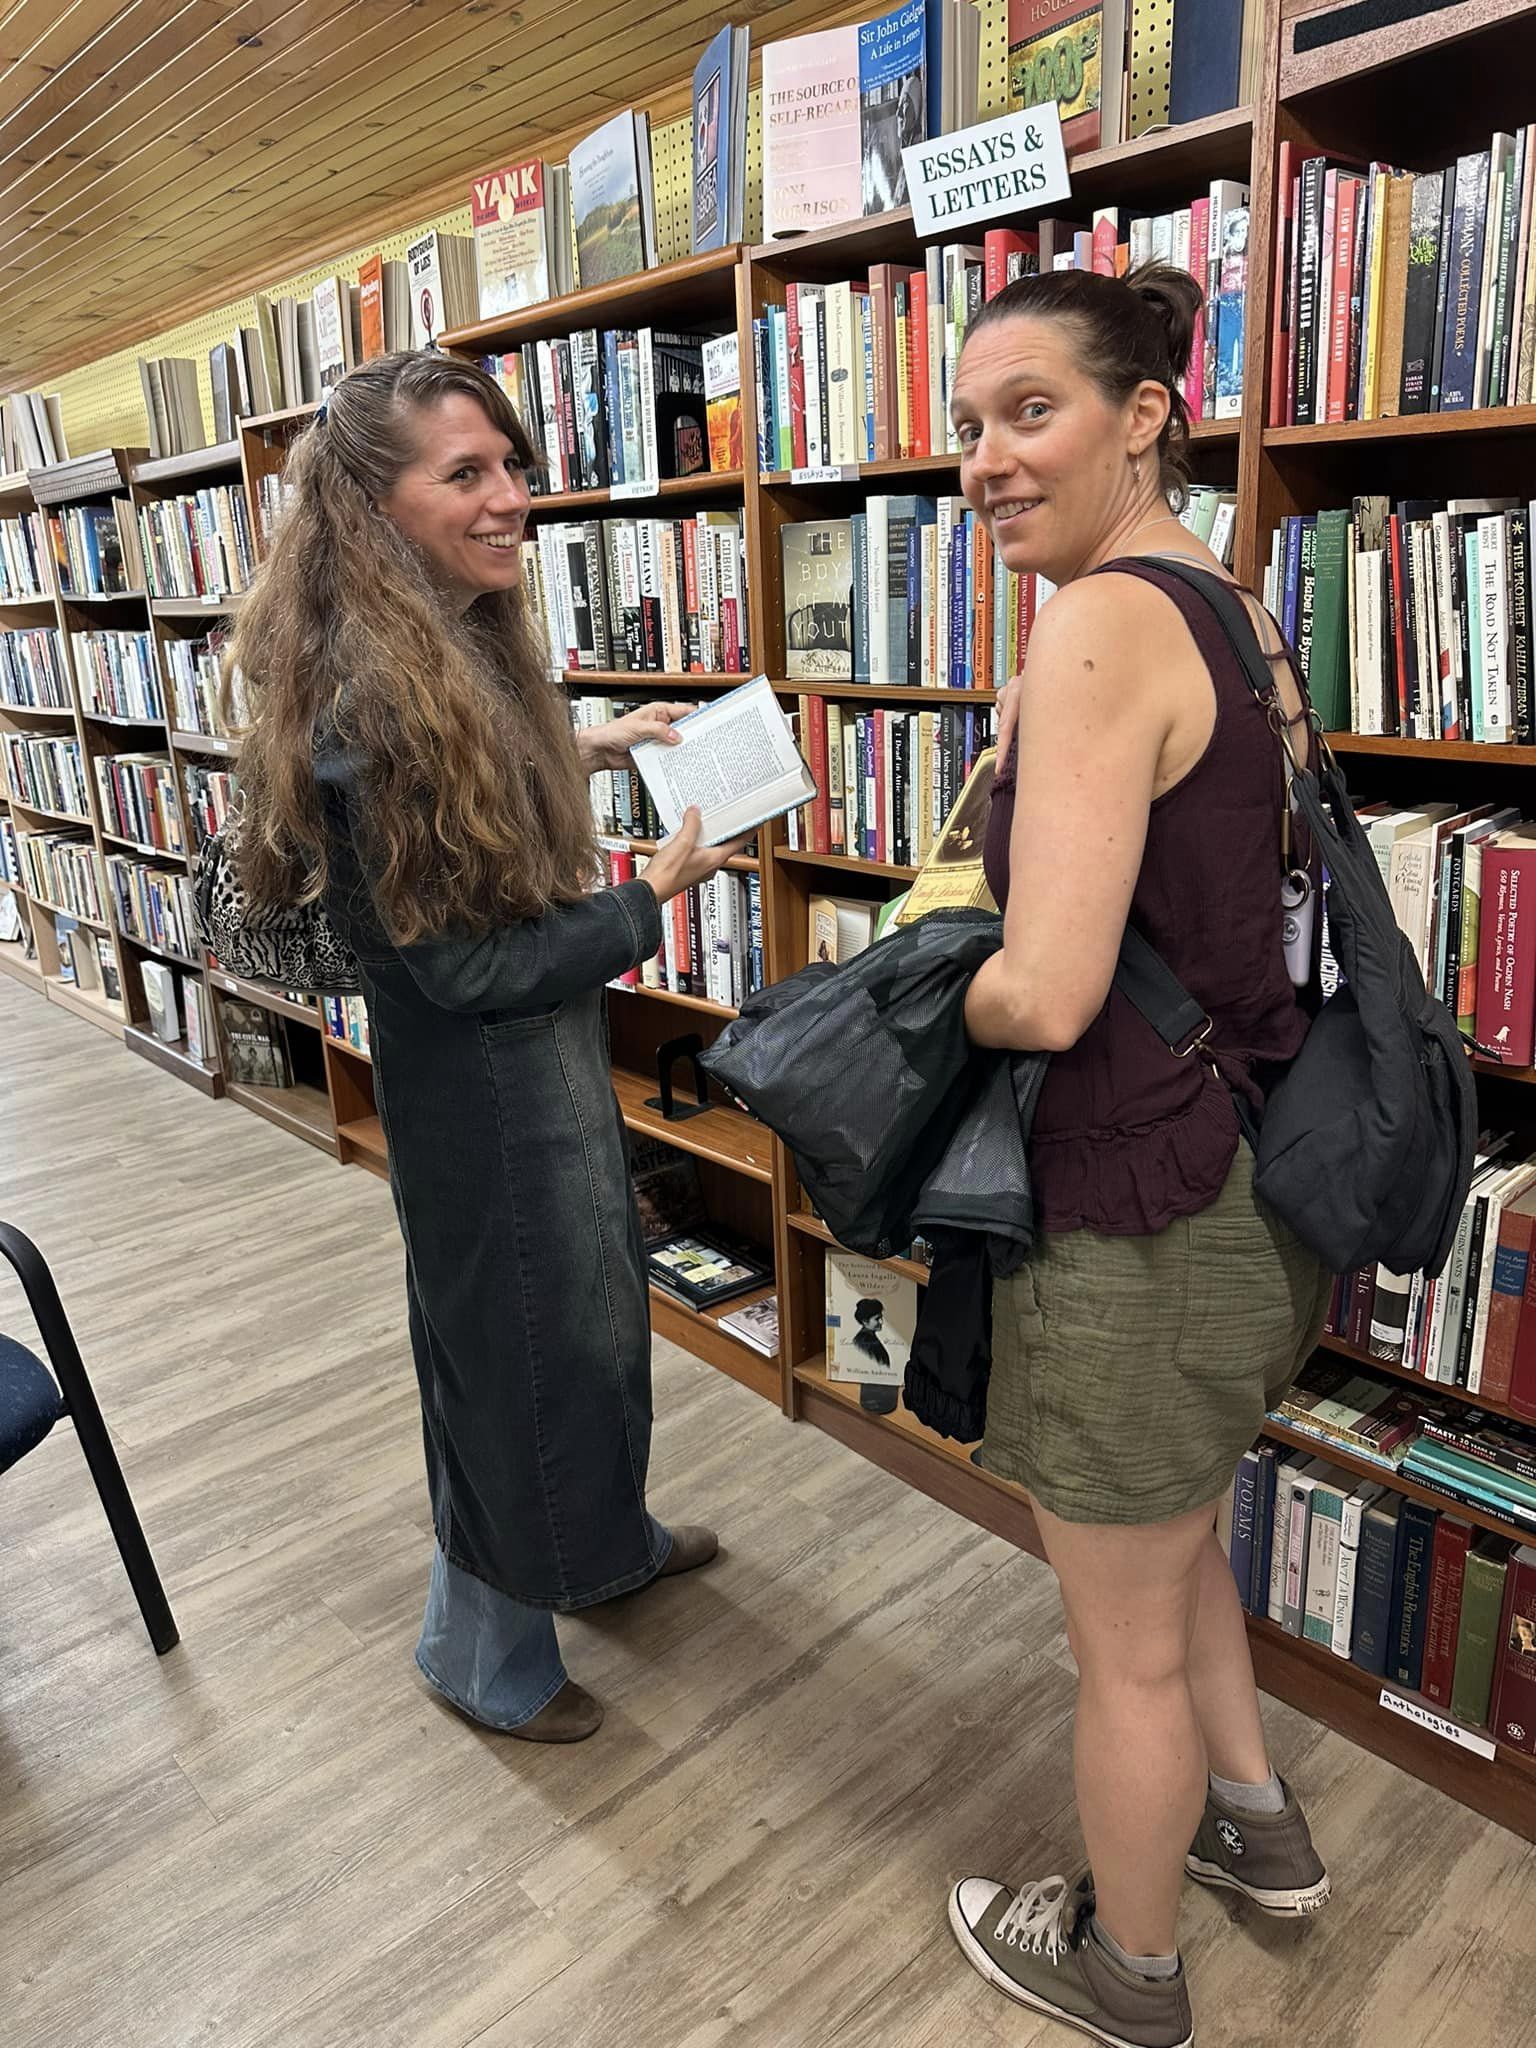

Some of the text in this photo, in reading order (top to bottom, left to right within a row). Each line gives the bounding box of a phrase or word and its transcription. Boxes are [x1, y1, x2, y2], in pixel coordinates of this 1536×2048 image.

[861, 30, 874, 45] Sir
[877, 19, 898, 42] John
[871, 27, 920, 60] A Life in Letters
[770, 77, 857, 106] THE SOURCE O
[919, 124, 1044, 184] ESSAYS &
[474, 165, 538, 210] YANK
[928, 162, 1048, 219] LETTERS
[1504, 183, 1512, 212] JAMES
[408, 234, 435, 263] BODYGUARD
[414, 254, 431, 275] OF LIES
[1499, 247, 1508, 293] EIGHTEEN
[1334, 207, 1350, 363] FLOW CHART JOHN ASHBERY
[912, 296, 920, 325] Torch
[1300, 279, 1313, 329] ARTHUR
[1454, 258, 1470, 349] COLLECTED POEMS
[1496, 297, 1504, 326] POEMS
[833, 332, 842, 365] Compass
[911, 329, 920, 356] Kept
[865, 350, 873, 375] CORY
[837, 383, 845, 413] William
[866, 378, 874, 414] BOOKER
[566, 427, 575, 454] NATION
[808, 532, 846, 550] THE
[1301, 530, 1311, 570] DICKEY
[1434, 525, 1442, 552] George
[1482, 526, 1490, 550] FROST
[588, 535, 603, 608] DICTIONARY
[611, 543, 621, 581] CANDY
[721, 539, 733, 592] COBRA II
[977, 560, 985, 588] hostile
[641, 524, 655, 657] TOM CLANCY Into the Storm
[699, 567, 708, 598] DREAM
[1436, 556, 1444, 598] Washington
[614, 582, 625, 634] BOMBERS
[624, 551, 642, 661] Tom Clancy Every Man
[1302, 575, 1315, 613] Babel
[594, 610, 603, 627] OF
[1301, 616, 1313, 633] To
[1484, 560, 1499, 706] THE ROAD NOT TAKEN
[1513, 542, 1528, 719] THE PROPHET KAHLIL GIBRAN
[975, 650, 983, 667] irby
[895, 763, 902, 771] in
[943, 749, 951, 773] Ashes
[943, 774, 951, 789] and
[631, 776, 640, 818] COMMAND
[942, 789, 952, 817] Sparks
[1451, 858, 1461, 913] POSTCARDS
[1499, 869, 1507, 885] 650
[750, 884, 761, 909] TIME
[1497, 885, 1507, 911] Rhymes,
[751, 911, 762, 927] FOR
[1496, 913, 1506, 934] Verses,
[752, 929, 762, 949] WAR
[1495, 935, 1504, 956] Lyrics,
[1503, 870, 1520, 1010] SELECTED POETRY OF OGDEN NASH
[1448, 963, 1456, 976] ED
[1495, 957, 1503, 971] and
[1455, 1212, 1469, 1279] WATCHING ANTS
[848, 1272, 897, 1282] Laura Ingalls
[859, 1282, 885, 1290] Wilder
[1358, 1283, 1369, 1294] Is
[846, 1367, 898, 1378] William Anderson
[1238, 1476, 1255, 1542] POEMS
[1497, 1511, 1515, 1524] PRESS
[1398, 1537, 1424, 1656] The English Romantics
[1426, 1556, 1447, 1663] and English Literature
[1439, 1565, 1463, 1657] The Enlightenment
[1382, 1692, 1461, 1739] Anthologies
[1298, 1887, 1327, 1902] CONVERSE
